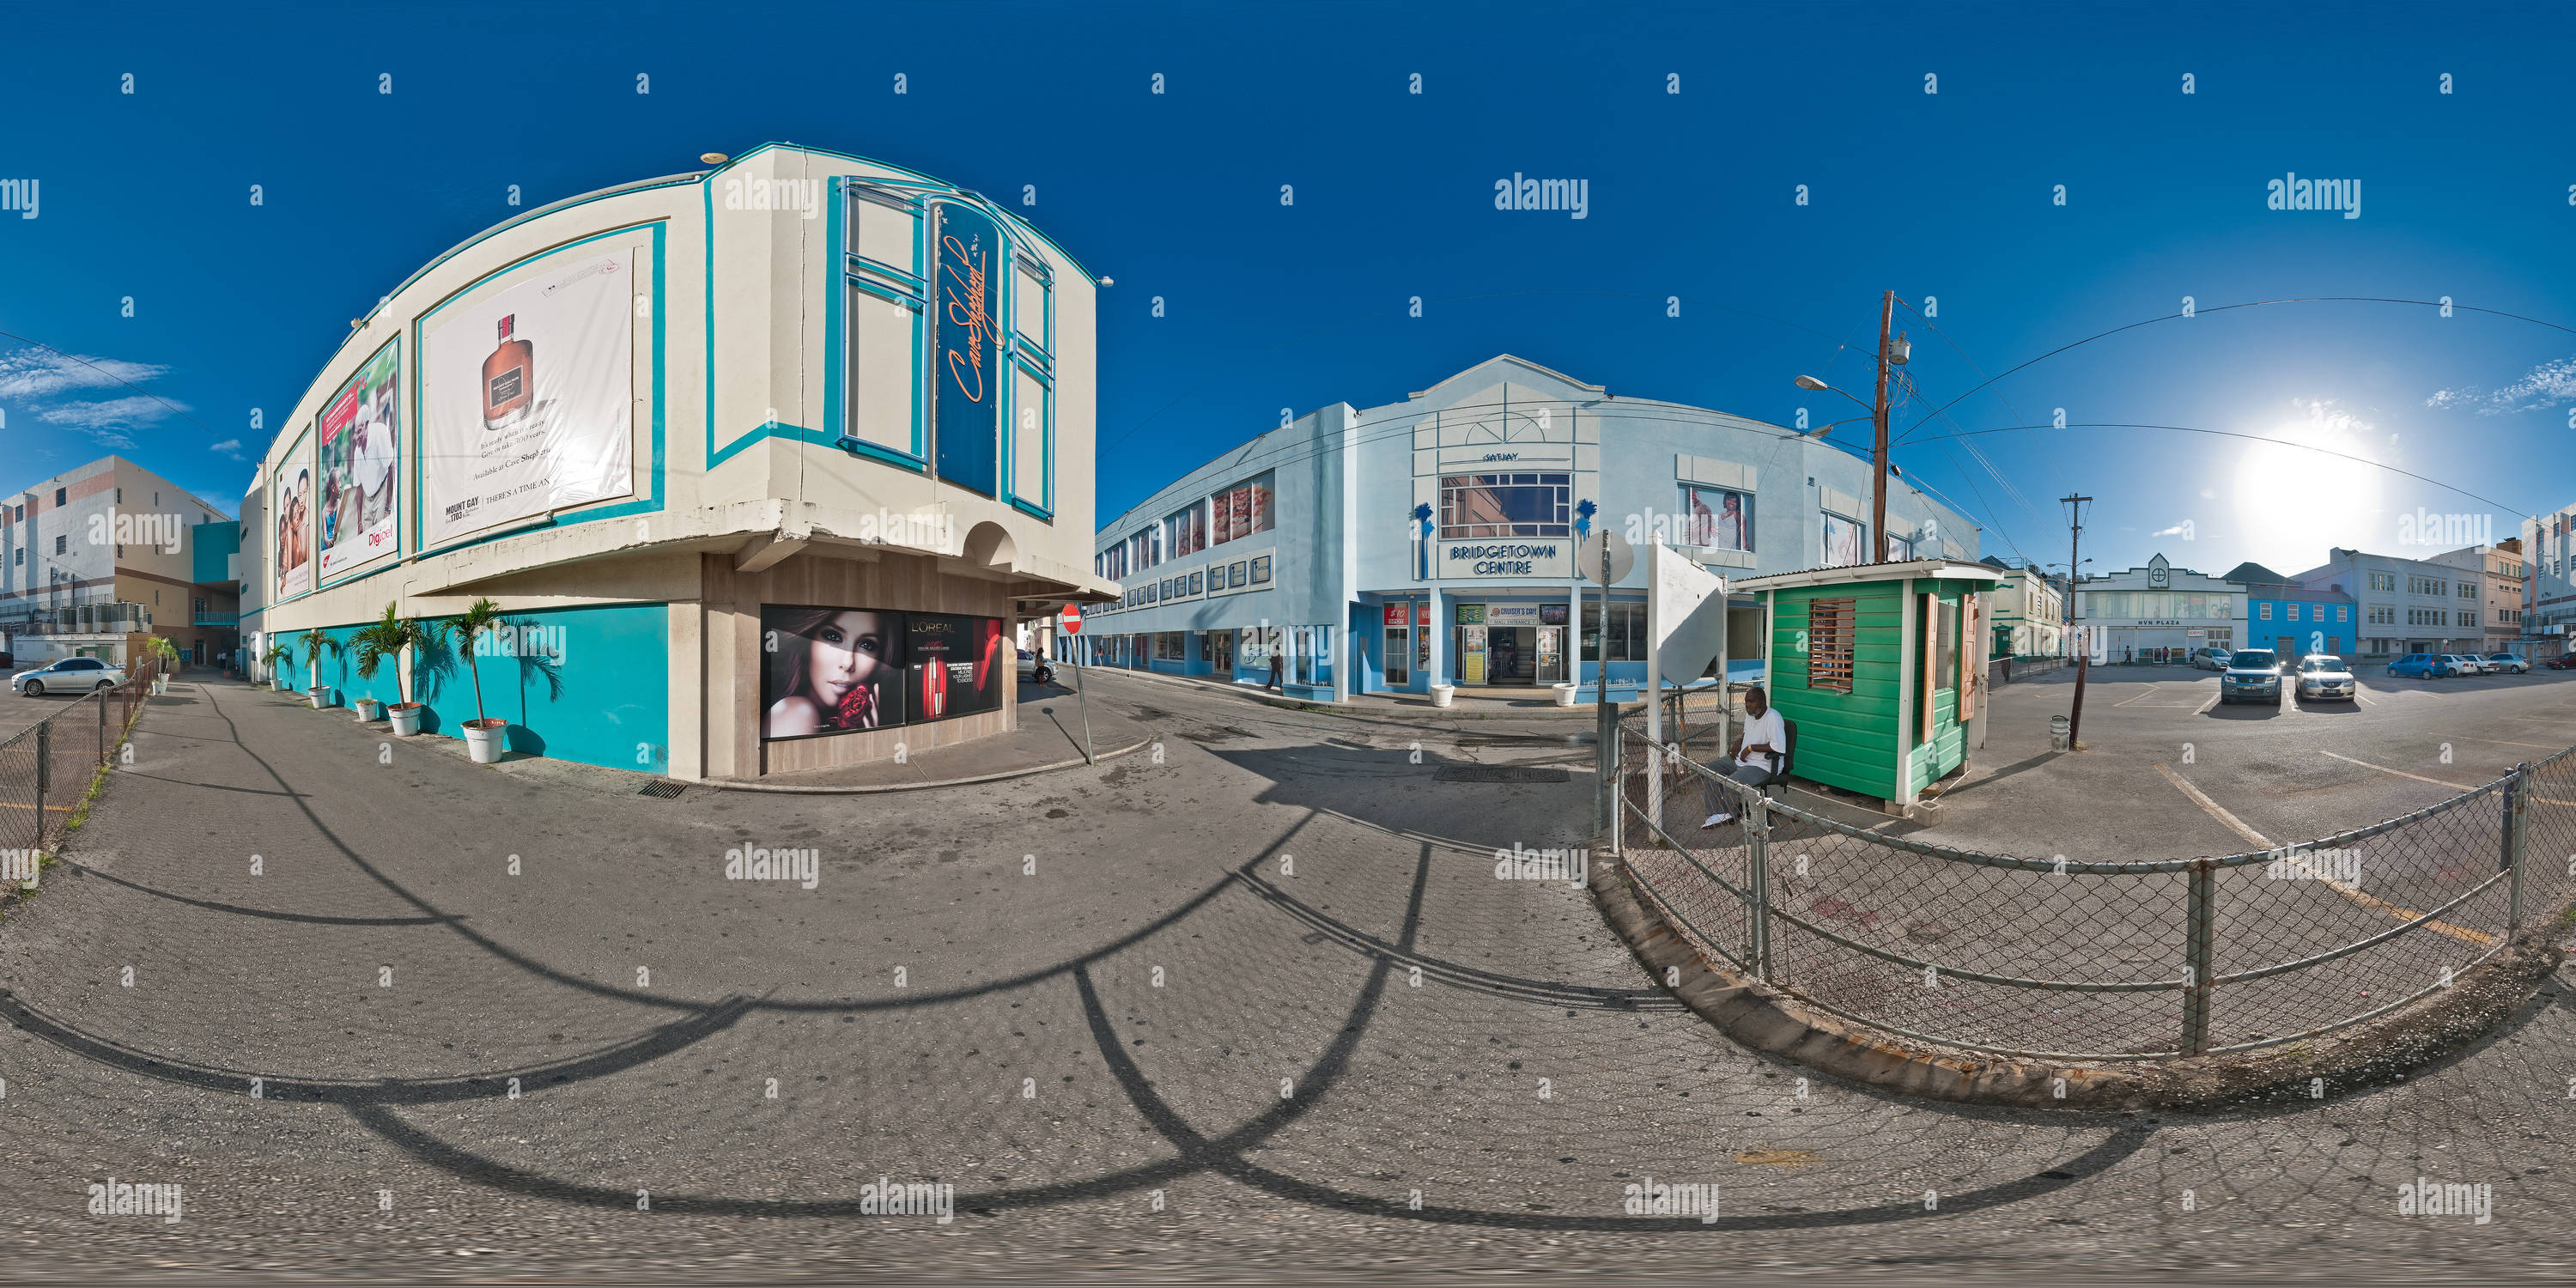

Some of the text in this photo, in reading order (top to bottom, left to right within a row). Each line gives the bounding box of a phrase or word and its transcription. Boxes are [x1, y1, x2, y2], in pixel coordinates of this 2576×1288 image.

[481, 450, 494, 459] Give
[1485, 453, 1519, 462] SATJAY
[473, 466, 497, 481] Available
[505, 459, 520, 468] Cave
[485, 489, 512, 505] THERE'S
[513, 487, 519, 495] A
[519, 481, 538, 493] TIME
[446, 495, 479, 515] MOUNT GAY
[451, 511, 463, 523] 1703
[1453, 544, 1557, 559] BRIDGETOWN
[1476, 561, 1533, 574] CENTRE
[1390, 610, 1406, 618] $10
